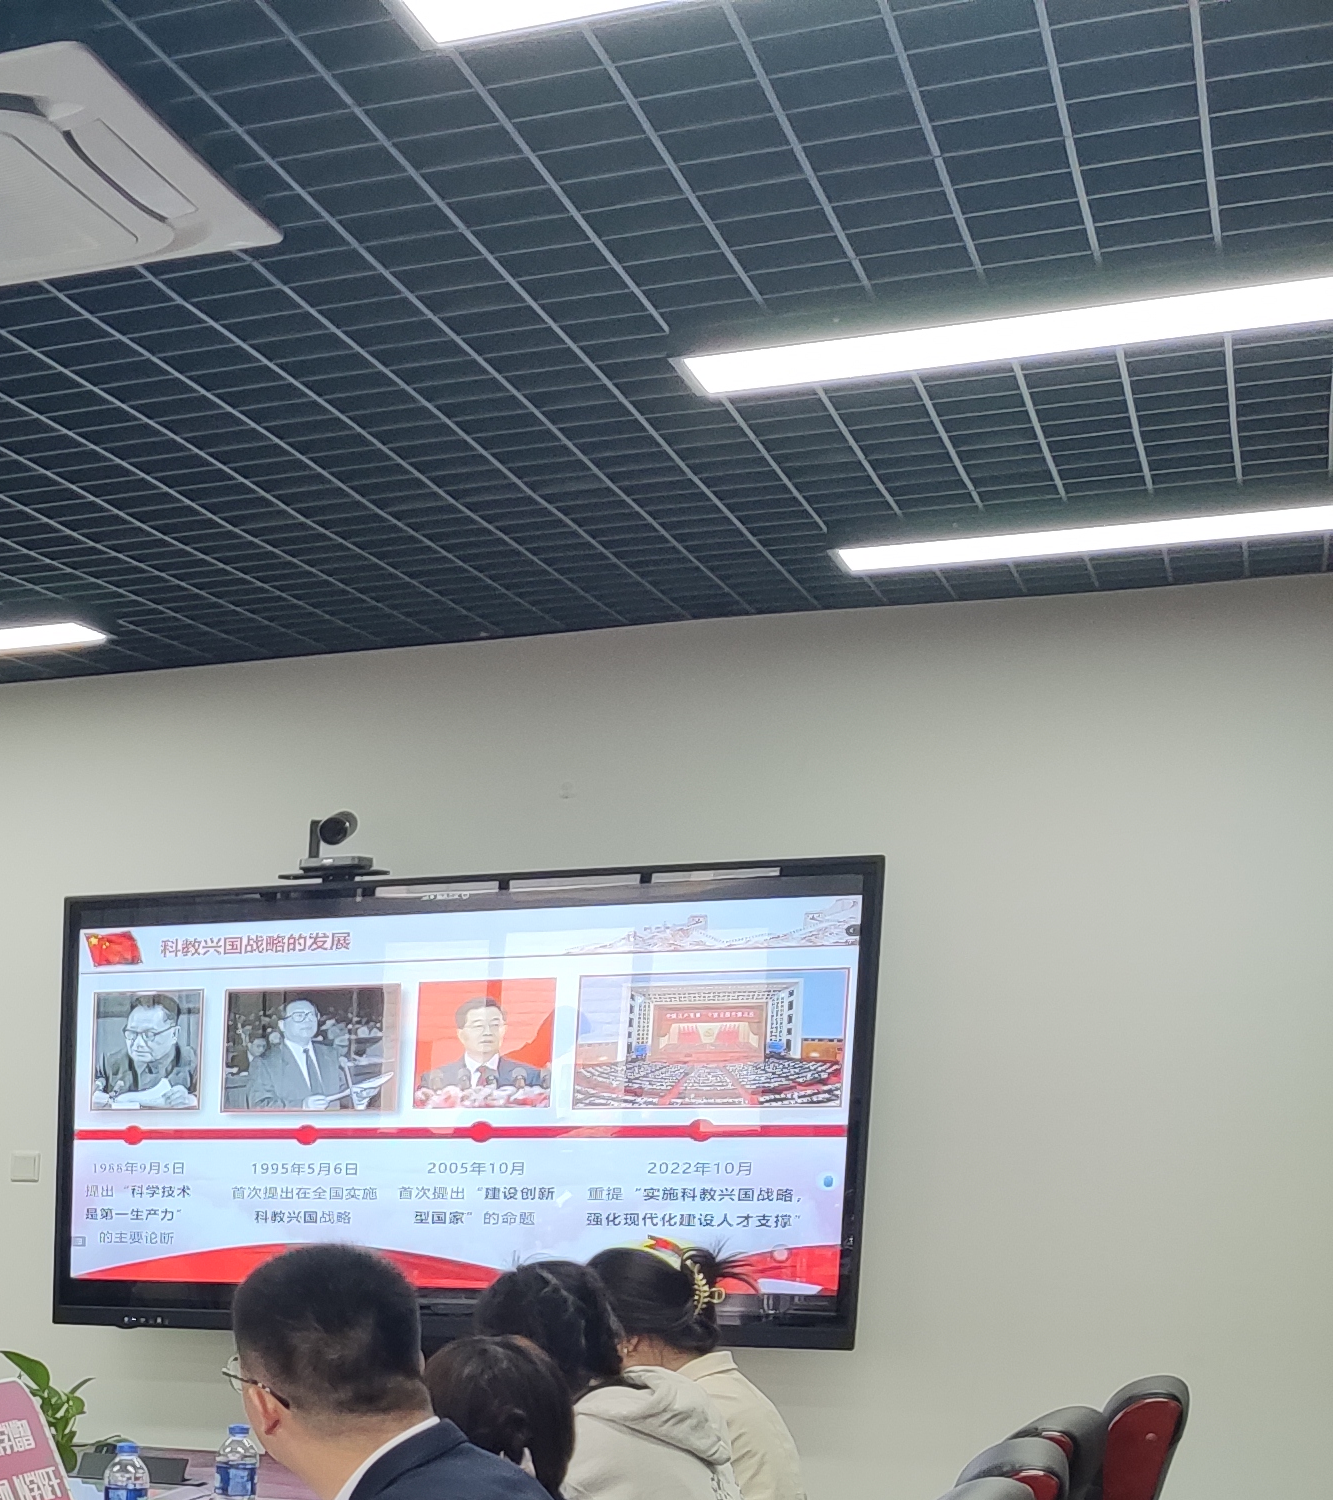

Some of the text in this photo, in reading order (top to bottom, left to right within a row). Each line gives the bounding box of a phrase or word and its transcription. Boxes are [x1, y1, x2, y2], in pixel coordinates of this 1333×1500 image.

[160, 932, 351, 957] 科教兴国战略的发展
[92, 1161, 185, 1176] 1988年9月5日
[251, 1161, 358, 1176] 1995年5月6日
[427, 1161, 526, 1176] 2005年10月
[647, 1161, 753, 1176] 2022年10月
[232, 1186, 378, 1201] 首次提出在全国实施
[254, 1210, 351, 1225] 科教兴国战略
[99, 1231, 175, 1245] 的主要论断
